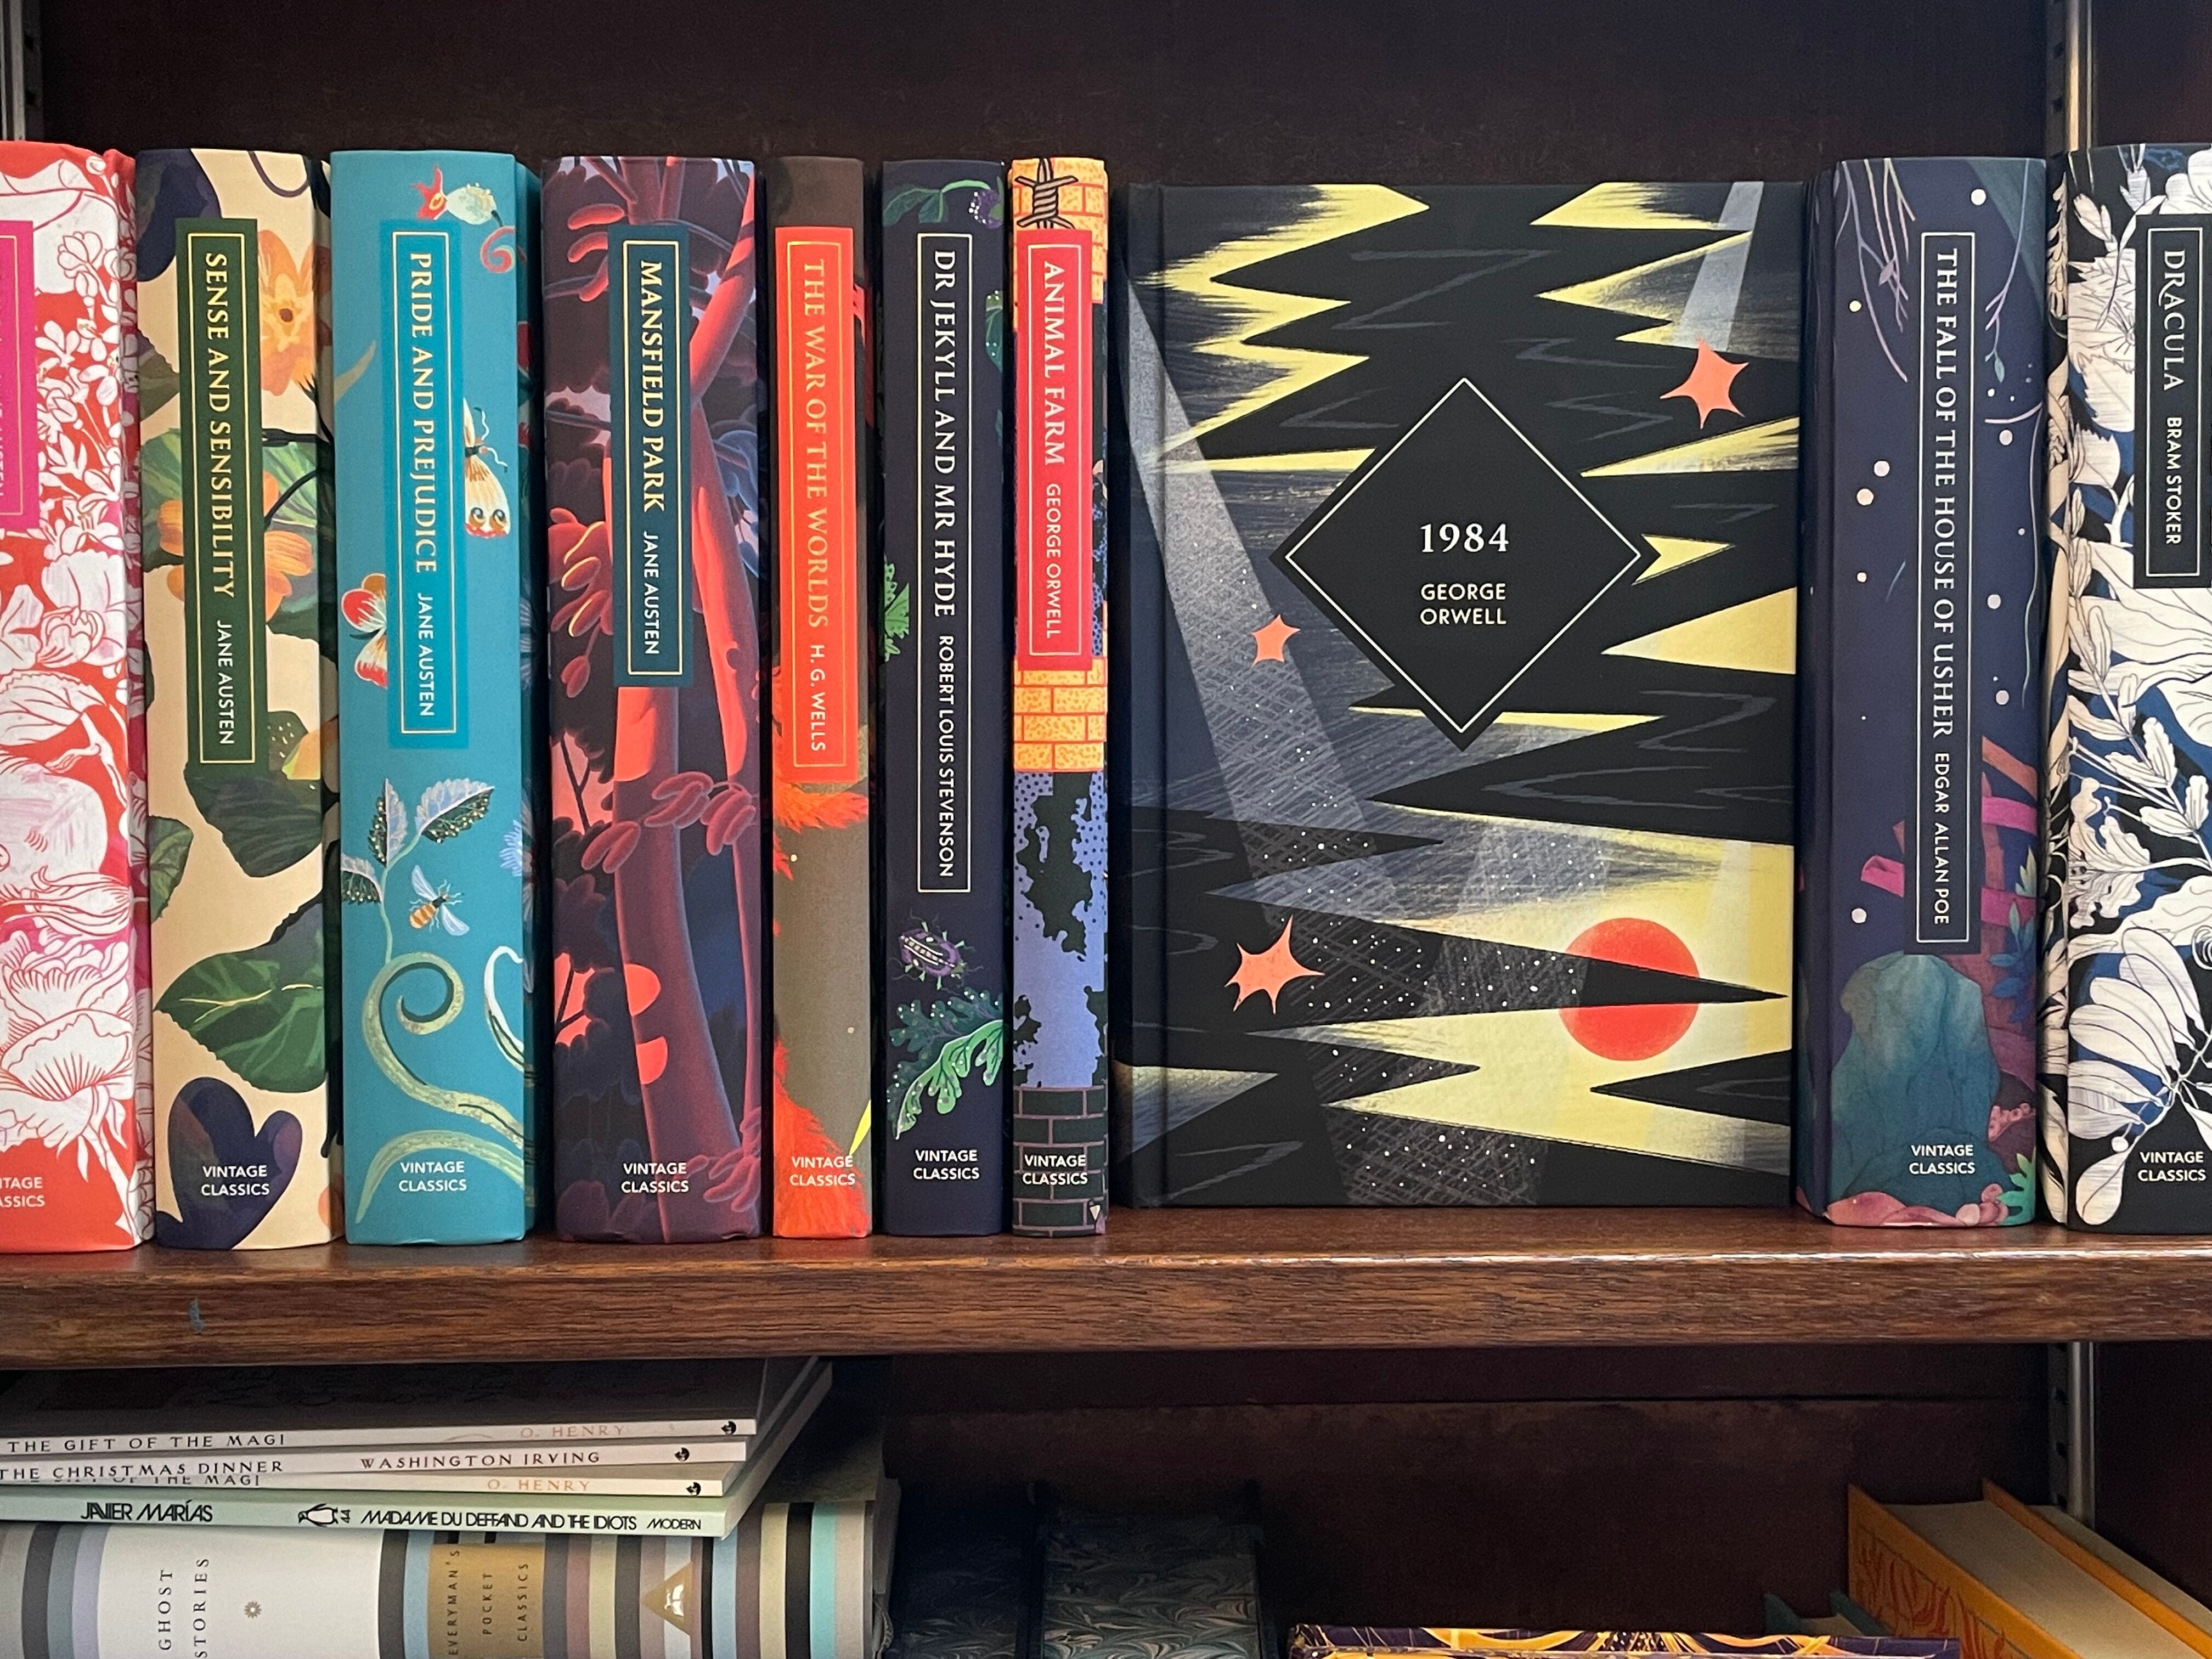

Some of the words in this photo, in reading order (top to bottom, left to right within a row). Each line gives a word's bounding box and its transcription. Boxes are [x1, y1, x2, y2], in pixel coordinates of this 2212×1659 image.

[206, 253, 229, 340] SENSE
[410, 253, 432, 338] PRIDE
[804, 258, 825, 315] THE
[935, 251, 955, 291] DR
[1937, 248, 1957, 306] THE
[641, 260, 663, 427] MANSFIELD
[1044, 261, 1065, 378] ANIMAL
[2158, 250, 2185, 391] DRACULA
[805, 325, 826, 392] WAR
[930, 300, 955, 402] JEKYLL
[1936, 315, 1957, 380] FALL
[207, 348, 230, 412] AND
[412, 347, 434, 409] AND
[1936, 387, 1956, 422] OF
[806, 398, 826, 433] OF
[935, 410, 955, 474] AND
[1045, 387, 1065, 465] FARM
[1935, 430, 1955, 487] THE
[2166, 417, 2182, 470] BRAM
[410, 419, 437, 573] PREJUDICE
[643, 436, 665, 512] PARK
[806, 442, 827, 499] THE
[210, 421, 234, 598] SENSIBILITY
[934, 484, 955, 530] MR
[1046, 483, 1062, 558] GEORGE
[2166, 475, 2182, 544] STOKER
[644, 531, 659, 578] JANE
[1420, 523, 1509, 552] 1984
[1934, 496, 1955, 590] HOUSE
[808, 507, 828, 628] WORLDS
[934, 540, 955, 617] HYDE
[1421, 583, 1506, 601] GEORGE
[417, 592, 434, 640] JANE
[644, 583, 660, 654] AUSTEN
[1046, 563, 1062, 639] ORWELL
[1420, 608, 1506, 625] ORWELL
[1934, 599, 1954, 634] OF
[217, 620, 233, 667] JANE
[810, 645, 825, 663] H.
[419, 645, 435, 716] AUSTEN
[810, 668, 826, 687] G.
[939, 636, 954, 705] ROBERT
[1933, 643, 1954, 738] USHER
[218, 674, 234, 744] AUSTEN
[811, 692, 826, 751] WELLS
[939, 709, 954, 763] LOUIS
[1934, 753, 1950, 813] EDGAR
[939, 768, 954, 877] STEVENSON
[1934, 822, 1949, 882] ALLAN
[1934, 889, 1949, 924] POE
[202, 1165, 268, 1177] VINTAGE
[400, 1160, 465, 1173] VINTAGE
[623, 1162, 687, 1175] VINTAGE
[791, 1155, 854, 1169] VINTAGE
[913, 1167, 980, 1180] CLASSICS
[915, 1149, 978, 1162] VINTAGE
[1024, 1154, 1087, 1167] VINTAGE
[1909, 1161, 1976, 1175] CLASSICS
[1911, 1144, 1974, 1156] VINTAGE
[2137, 1169, 2207, 1182] CLASSICS
[2140, 1151, 2204, 1164] VINTAGE
[0, 1176, 43, 1189] TAGE
[0, 1195, 45, 1208] SSICS
[201, 1183, 270, 1196] CLASSICS
[399, 1178, 467, 1192] CLASSICS
[621, 1180, 689, 1193] CLASSICS
[789, 1173, 855, 1187] CLASSICS
[1023, 1172, 1088, 1186] CLASSICS
[7, 1441, 50, 1453] THE
[64, 1438, 116, 1451] GIFT
[128, 1437, 157, 1449] OF
[169, 1436, 213, 1448] THE
[225, 1434, 284, 1447] MAGI
[552, 1425, 624, 1438] HENRY
[52, 1464, 186, 1479] CHRISTMAS
[199, 1461, 283, 1474] DINNER
[205, 1474, 259, 1486] MAGI
[360, 1453, 513, 1469] WASHINGTON
[523, 1451, 601, 1466] IRVING
[518, 1479, 590, 1492] HENRY
[81, 1503, 133, 1521] JAVIER
[136, 1499, 213, 1522] MARÍAS
[360, 1510, 438, 1526] MADAME
[441, 1511, 462, 1526] DU
[466, 1512, 529, 1528] DEFFAND
[531, 1514, 565, 1528] AND
[567, 1514, 590, 1529] THE
[594, 1515, 637, 1530] IDIOTS
[646, 1518, 701, 1530] MODERN
[158, 1570, 173, 1651] GHOST
[193, 1559, 209, 1658] STORIES
[445, 1550, 460, 1655] EVERYMAN'S
[482, 1573, 493, 1635] POCKET
[517, 1564, 529, 1642] CLASSICS
